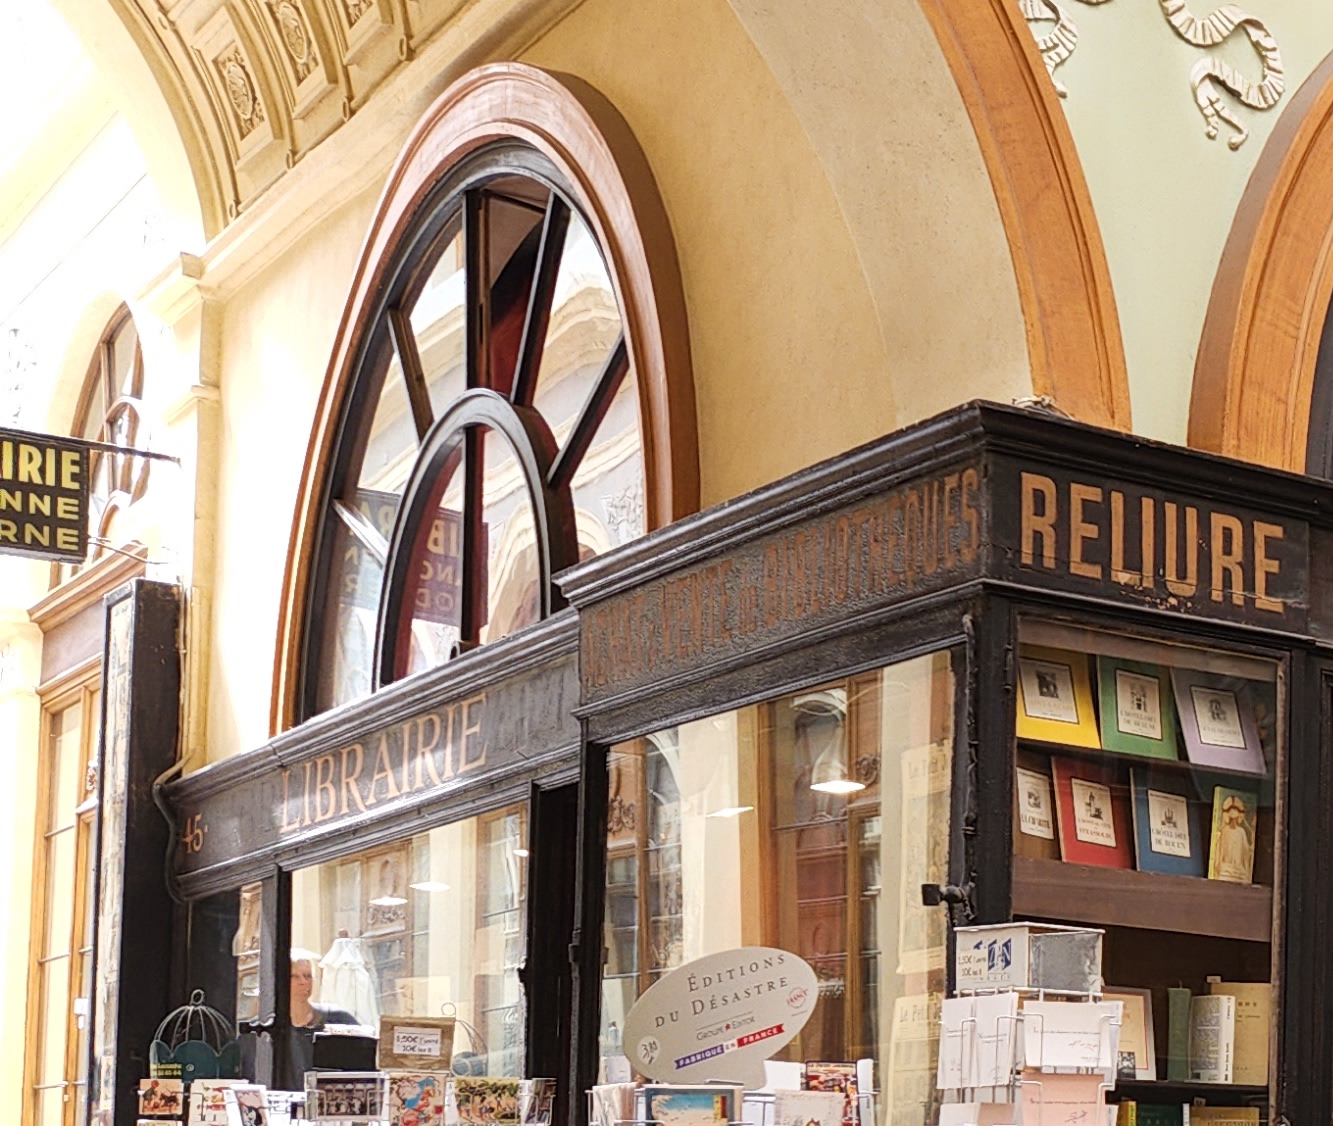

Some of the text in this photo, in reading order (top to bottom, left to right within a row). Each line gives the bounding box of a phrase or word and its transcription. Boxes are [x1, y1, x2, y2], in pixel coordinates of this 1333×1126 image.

[1020, 471, 1285, 613] RELIURE
[279, 692, 488, 833] LIBRAIRIE
[687, 954, 786, 993] ÉDITIONS
[655, 1010, 679, 1028] DU
[692, 976, 789, 1016] DÉSASTRE
[726, 1042, 736, 1051] EN
[743, 1026, 779, 1044] FRANCE
